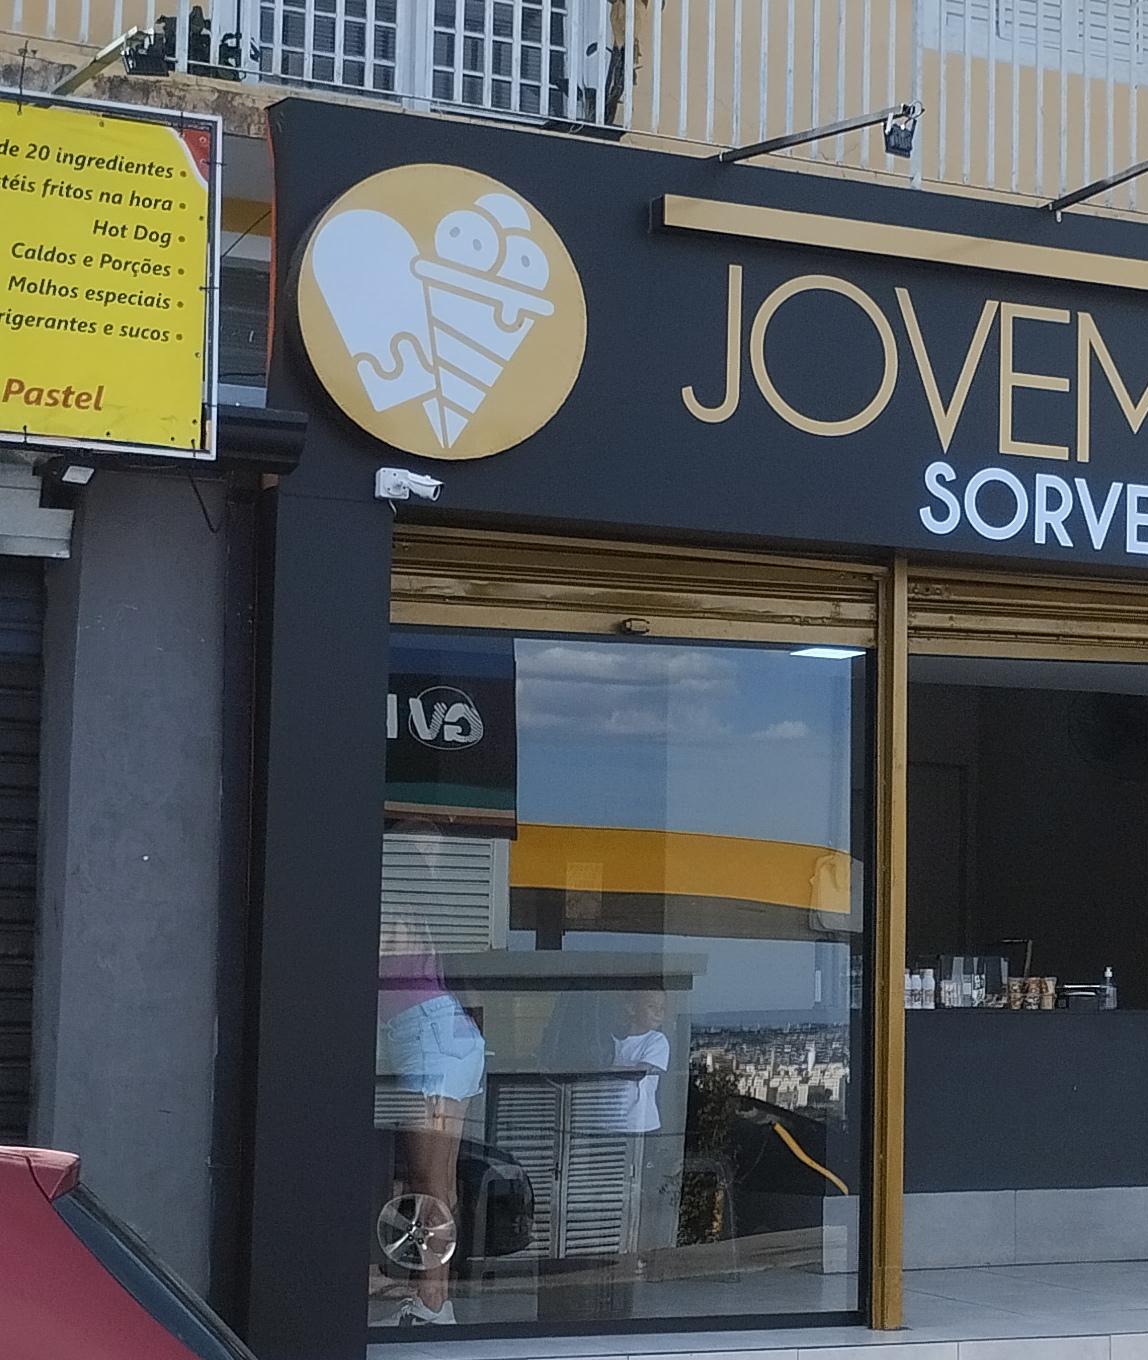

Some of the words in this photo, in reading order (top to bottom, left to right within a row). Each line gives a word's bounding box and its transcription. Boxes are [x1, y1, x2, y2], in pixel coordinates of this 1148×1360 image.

[0, 138, 20, 158] de
[25, 143, 51, 162] 20
[56, 146, 175, 179] ingredientes
[41, 178, 94, 201] fritos
[98, 190, 123, 206] na
[128, 189, 174, 212] hora
[92, 219, 129, 239] Hot
[133, 224, 172, 249] Dog
[11, 242, 77, 266] Caldos
[82, 255, 94, 268] e
[99, 253, 172, 278] Porções
[7, 274, 79, 299] Molhos
[84, 287, 172, 310] especiais
[102, 323, 114, 336] e
[118, 324, 171, 343] sucos
[2, 377, 105, 412] Pastel
